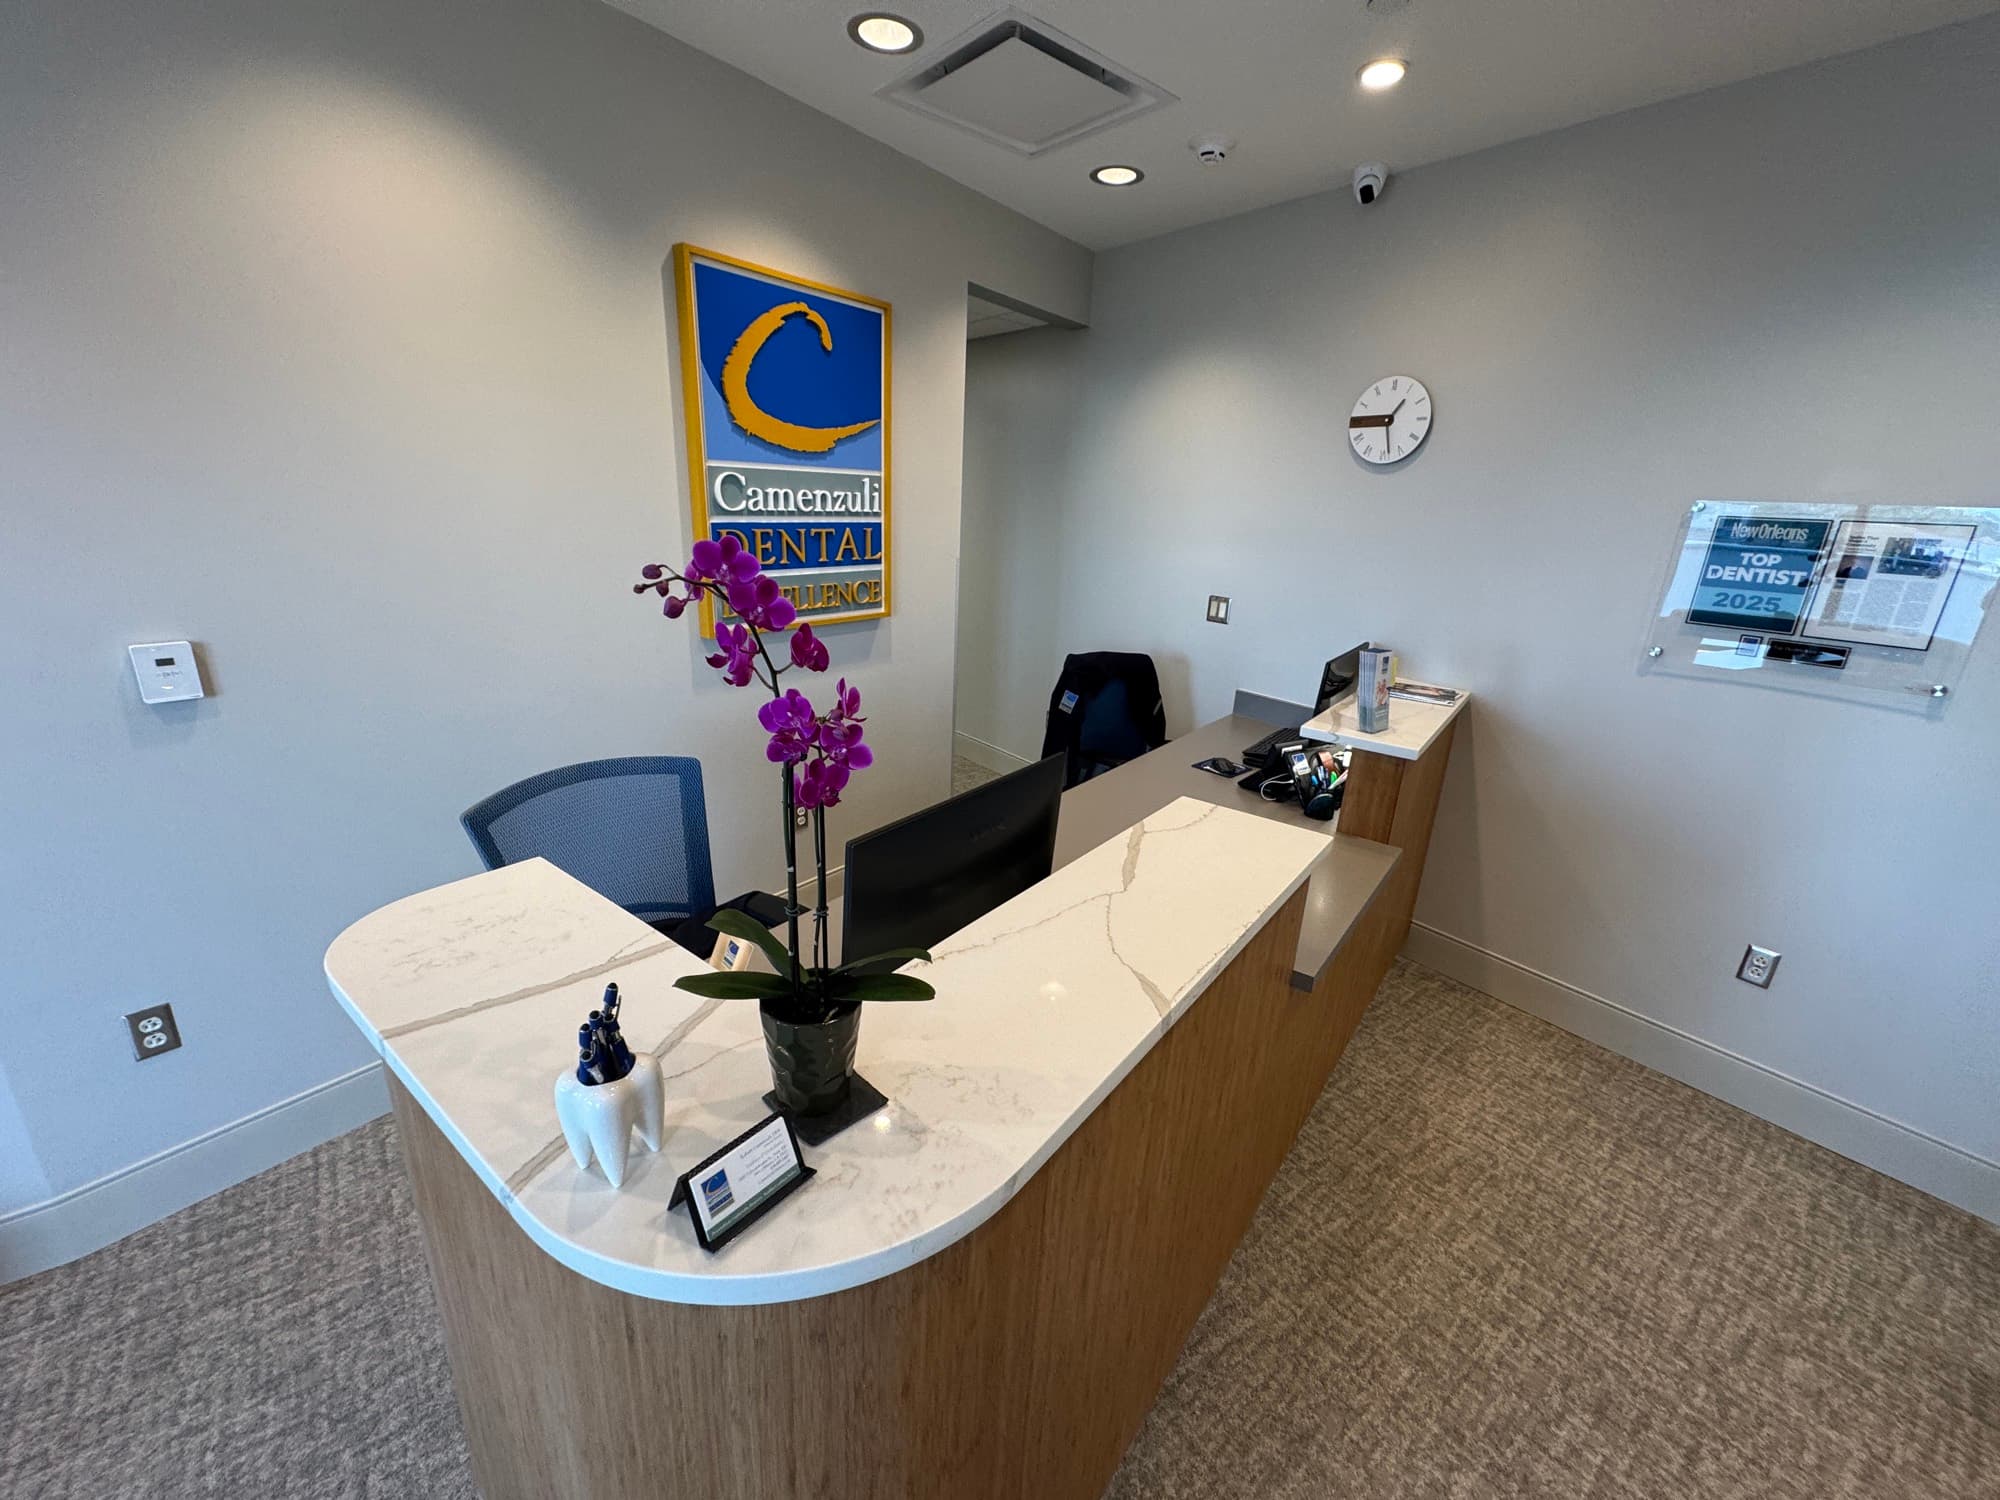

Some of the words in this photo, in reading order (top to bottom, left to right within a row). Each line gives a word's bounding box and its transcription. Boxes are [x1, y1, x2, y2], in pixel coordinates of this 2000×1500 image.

[714, 471, 881, 513] Camenzuli
[1740, 552, 1783, 567] TOP
[1705, 565, 1808, 586] DENTIST
[723, 580, 881, 618] LLENCE
[1712, 592, 1782, 612] 2025
